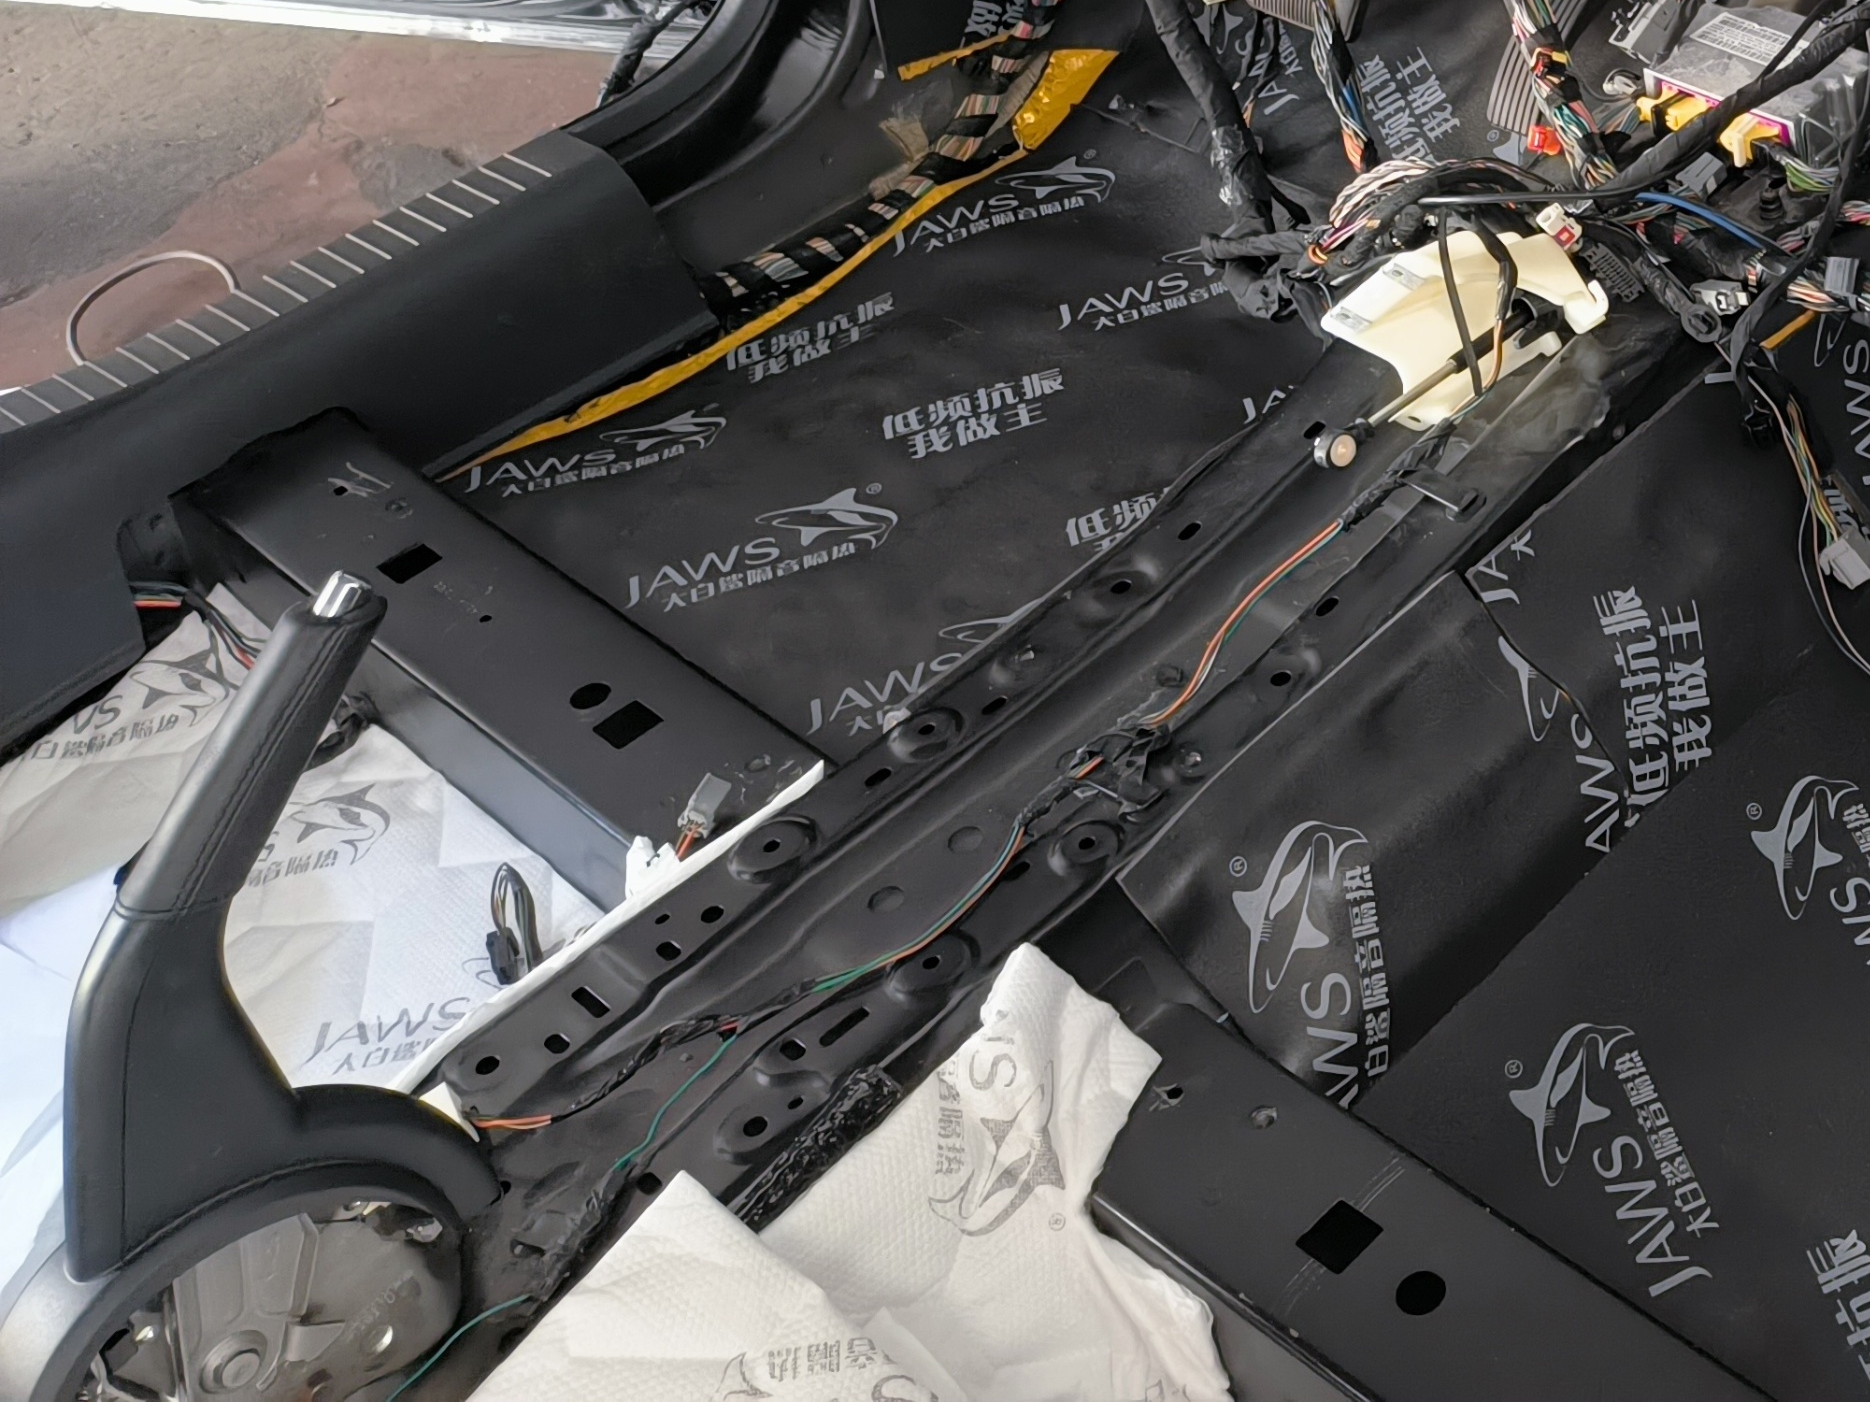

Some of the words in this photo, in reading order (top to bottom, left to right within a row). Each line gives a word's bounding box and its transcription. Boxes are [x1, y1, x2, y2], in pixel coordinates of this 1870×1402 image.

[1396, 46, 1460, 143] 我做主
[893, 192, 1019, 256] JAWS
[726, 293, 897, 372] 低频抗振
[1057, 271, 1190, 331] JAWS
[749, 322, 881, 383] 我做主
[882, 369, 1065, 440] 低频抗振
[907, 407, 1048, 459] 我做主
[465, 448, 617, 493] JAWS
[623, 538, 780, 610] JAWS
[1658, 599, 1711, 771] 我做主
[1594, 1136, 1712, 1297] JAWS
